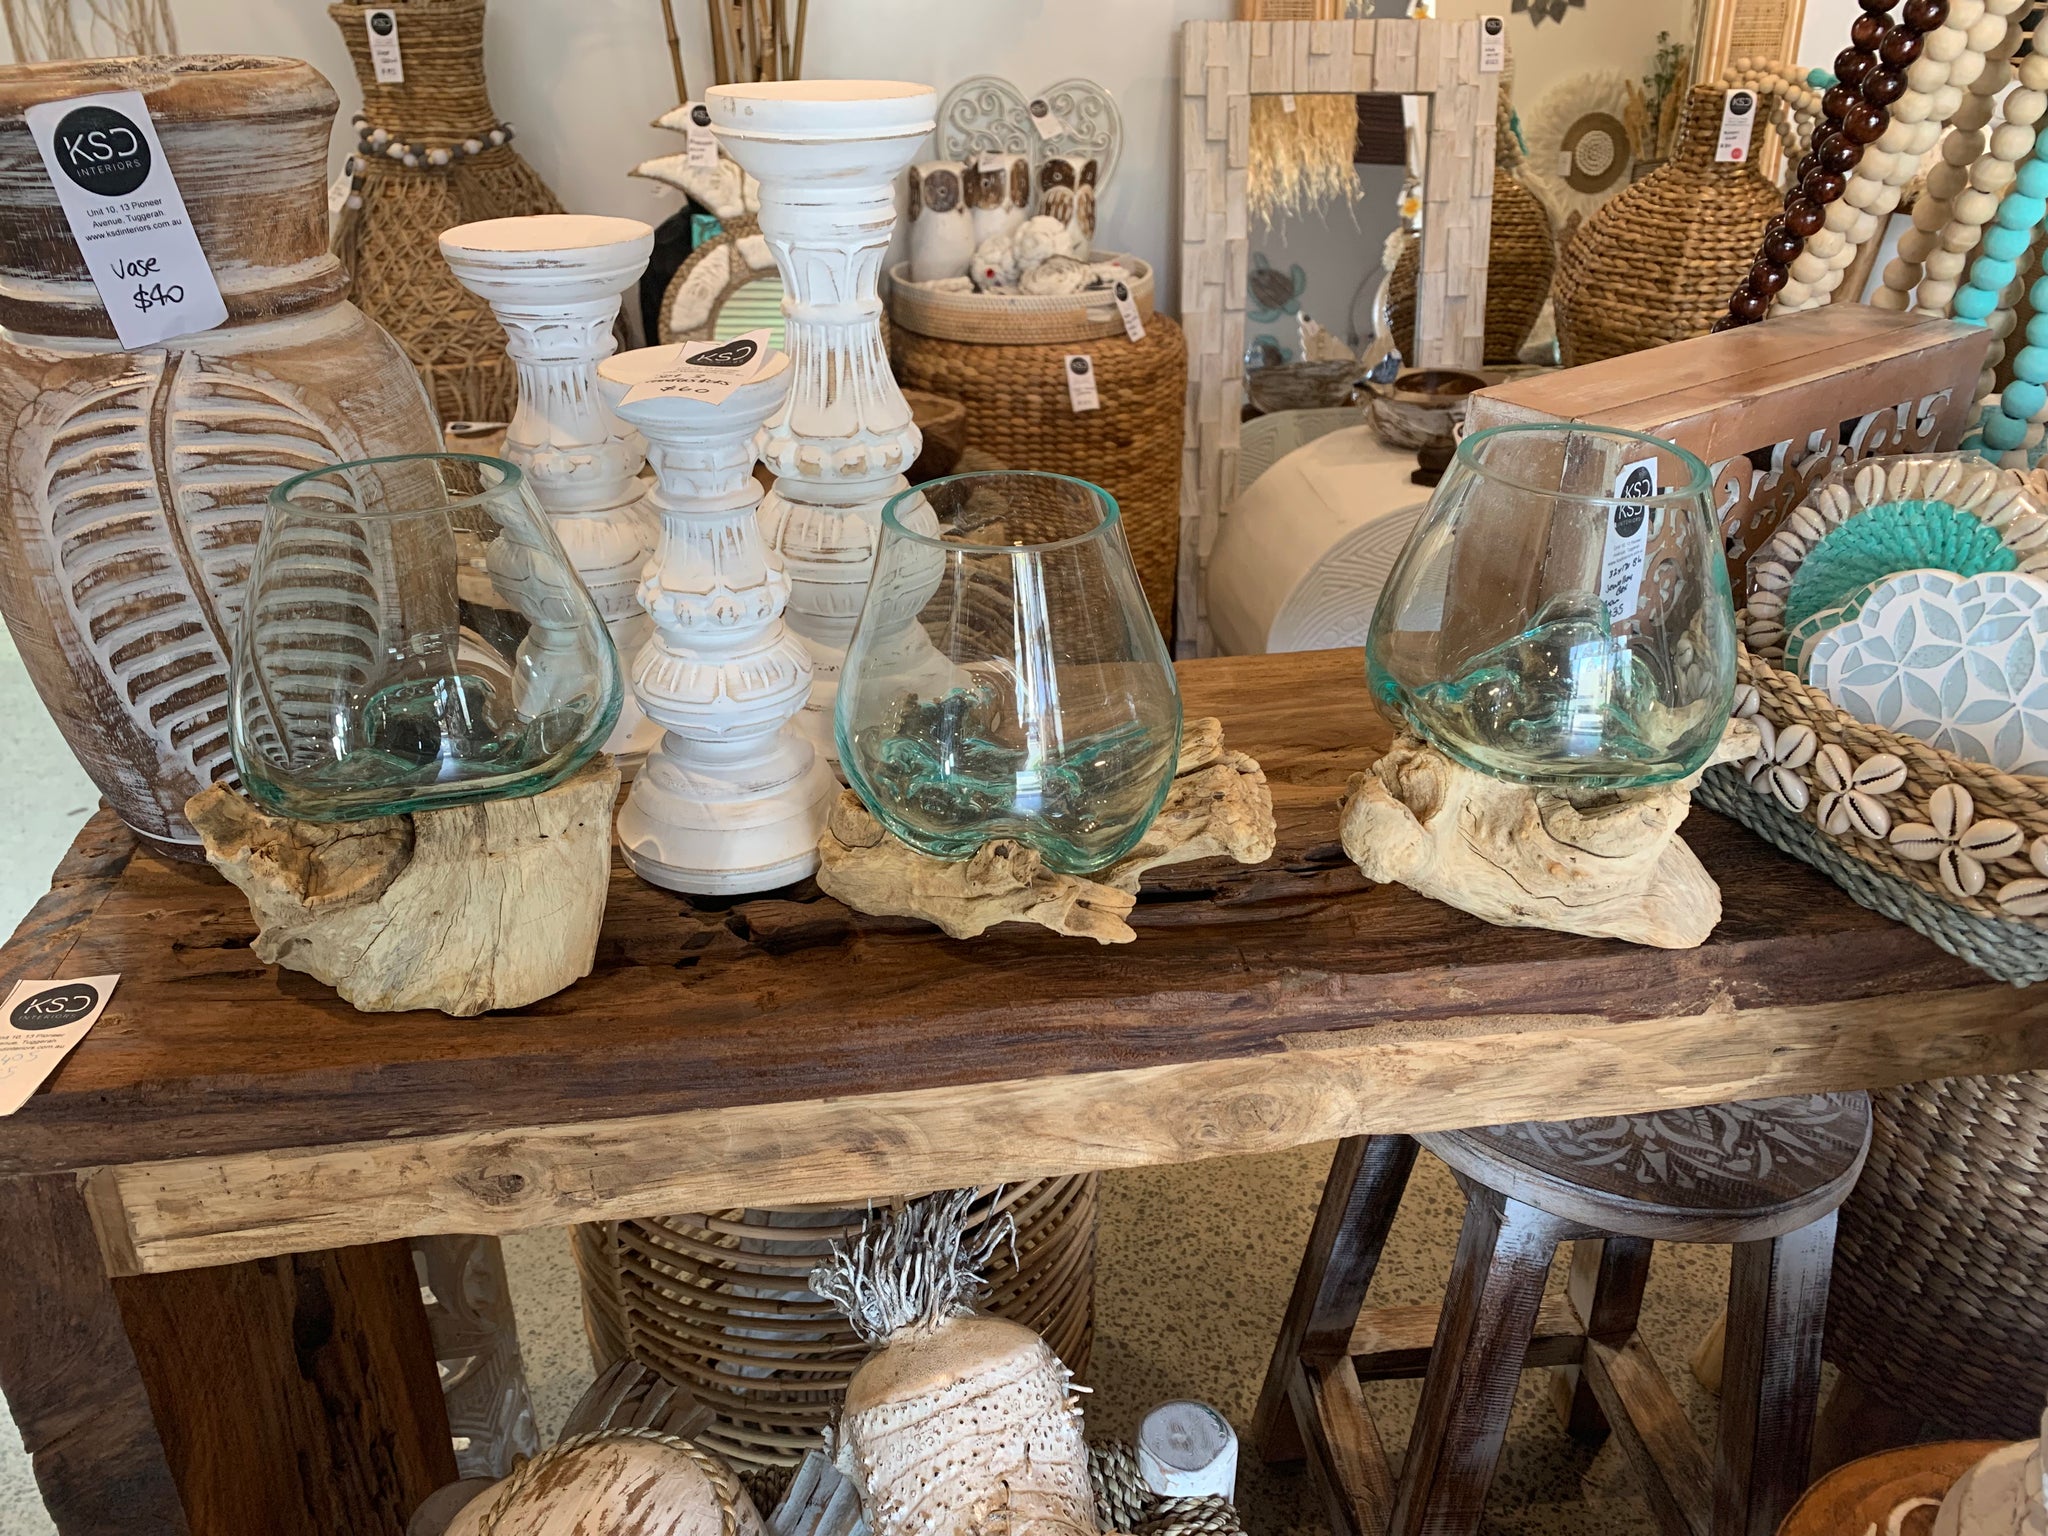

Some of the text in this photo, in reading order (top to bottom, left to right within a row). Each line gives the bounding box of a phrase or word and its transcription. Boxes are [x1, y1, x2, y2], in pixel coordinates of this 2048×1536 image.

[63, 127, 138, 165] KSD
[76, 158, 142, 177] INTERIORS
[86, 207, 105, 218] Unit
[119, 203, 131, 212] 13
[131, 198, 163, 210] Pioneer
[126, 209, 164, 224] Tuggerah
[110, 257, 161, 280] Vase
[133, 283, 184, 313] $40
[697, 346, 752, 361] KSD
[660, 385, 710, 394] $60
[1625, 479, 1650, 499] KSD
[24, 995, 91, 1014] KSD
[18, 1012, 76, 1021] INTERIORS
